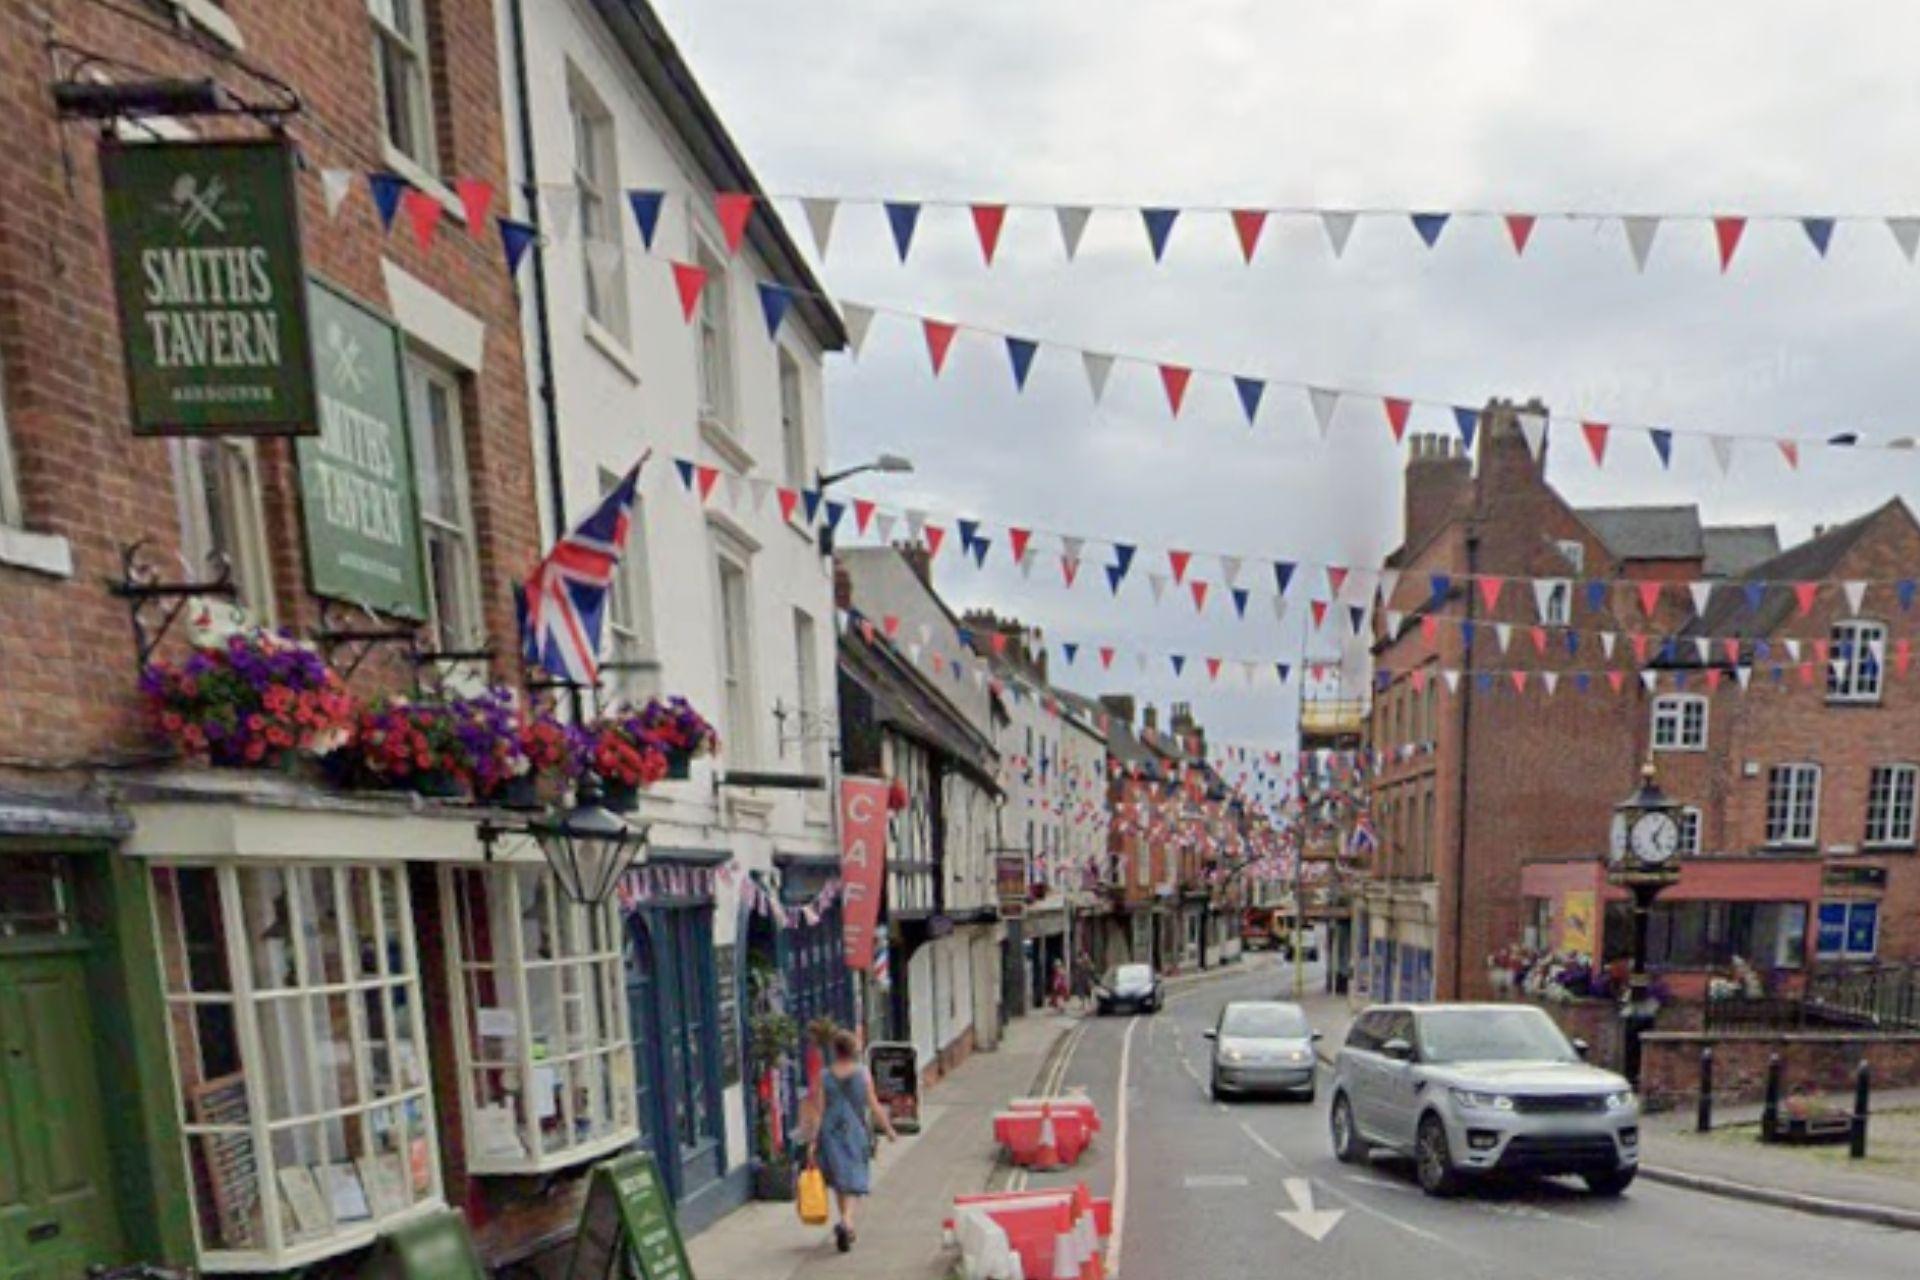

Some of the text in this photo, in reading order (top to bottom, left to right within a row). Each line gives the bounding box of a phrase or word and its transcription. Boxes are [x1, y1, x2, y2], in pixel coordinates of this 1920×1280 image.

[142, 246, 273, 303] SMITHS
[144, 311, 282, 366] TAVERN
[314, 459, 402, 546] TAVERN
[843, 793, 876, 955] CAFE
